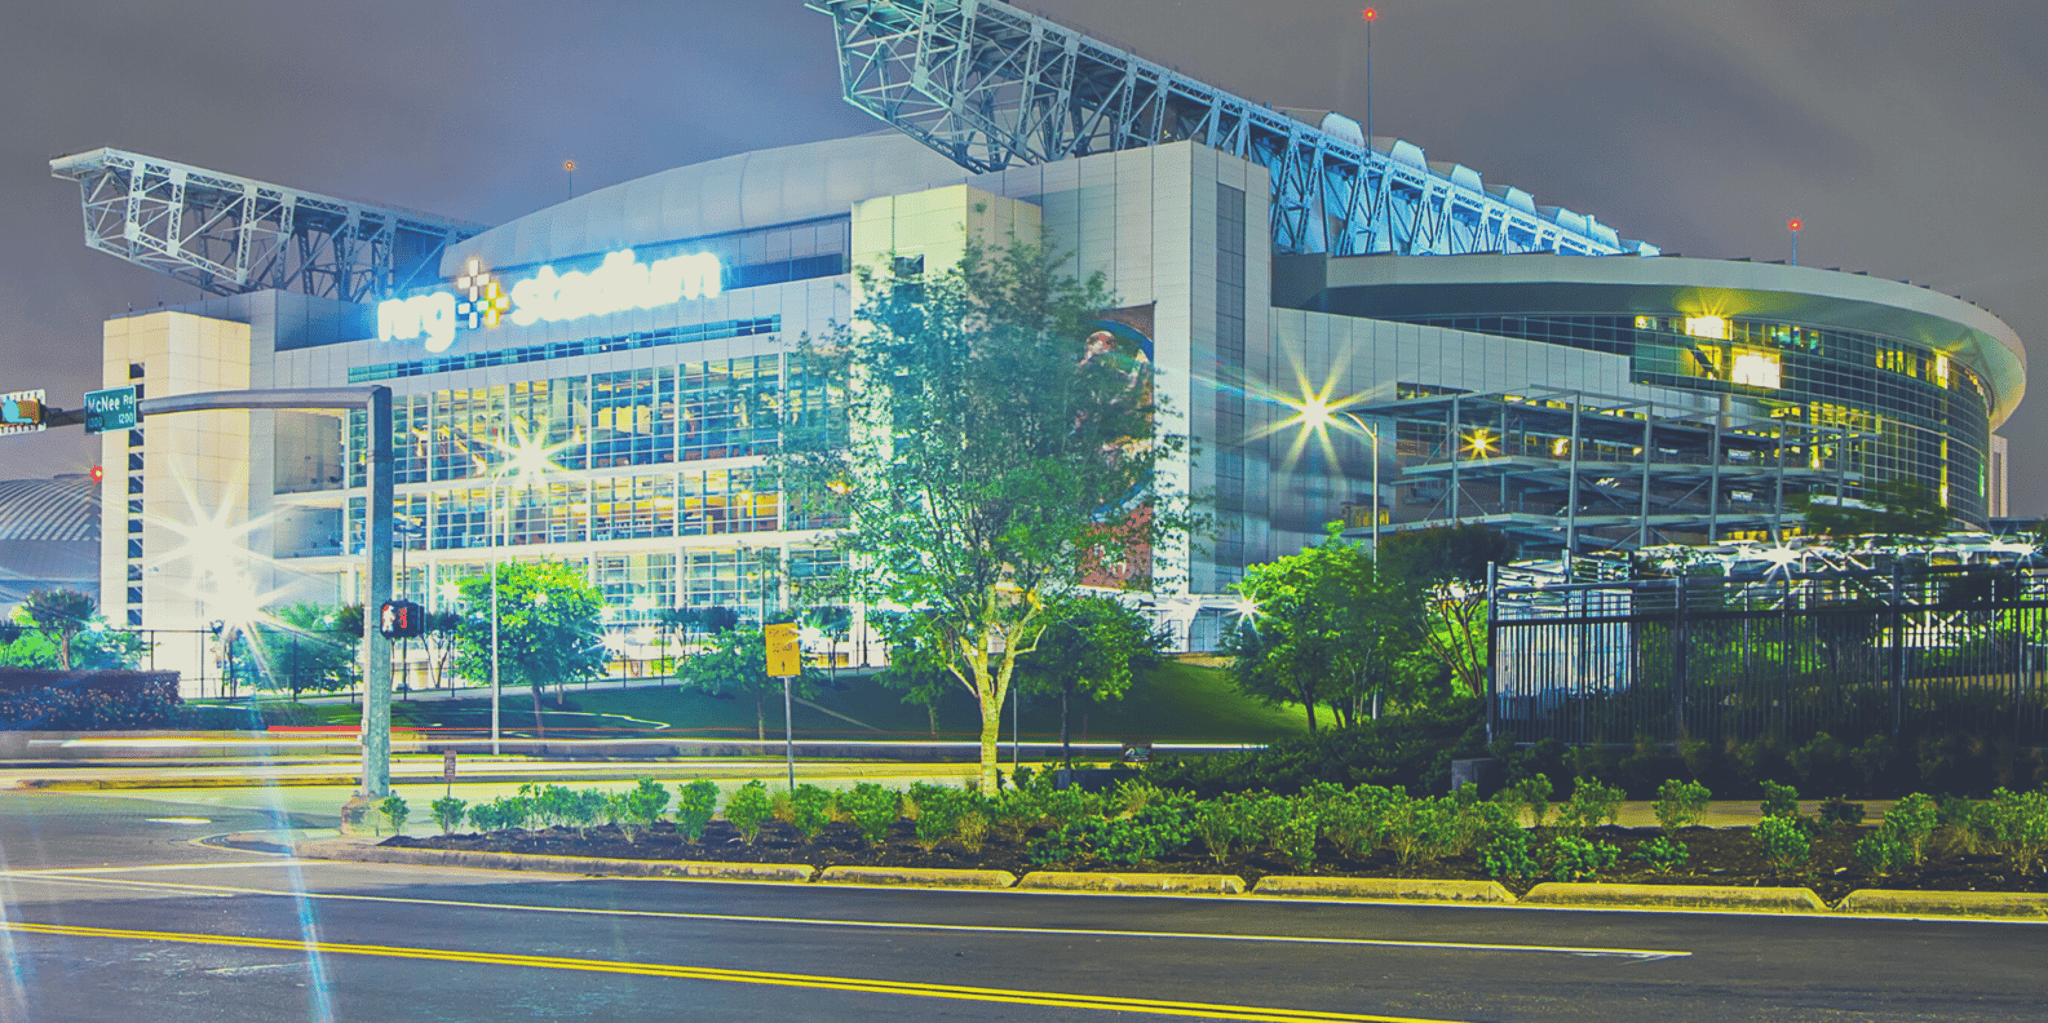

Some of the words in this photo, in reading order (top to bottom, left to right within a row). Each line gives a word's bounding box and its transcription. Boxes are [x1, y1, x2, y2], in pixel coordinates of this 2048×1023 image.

[378, 291, 456, 353] nrg
[510, 249, 721, 326] stadium
[88, 395, 120, 412] McNee
[123, 395, 133, 405] Rd
